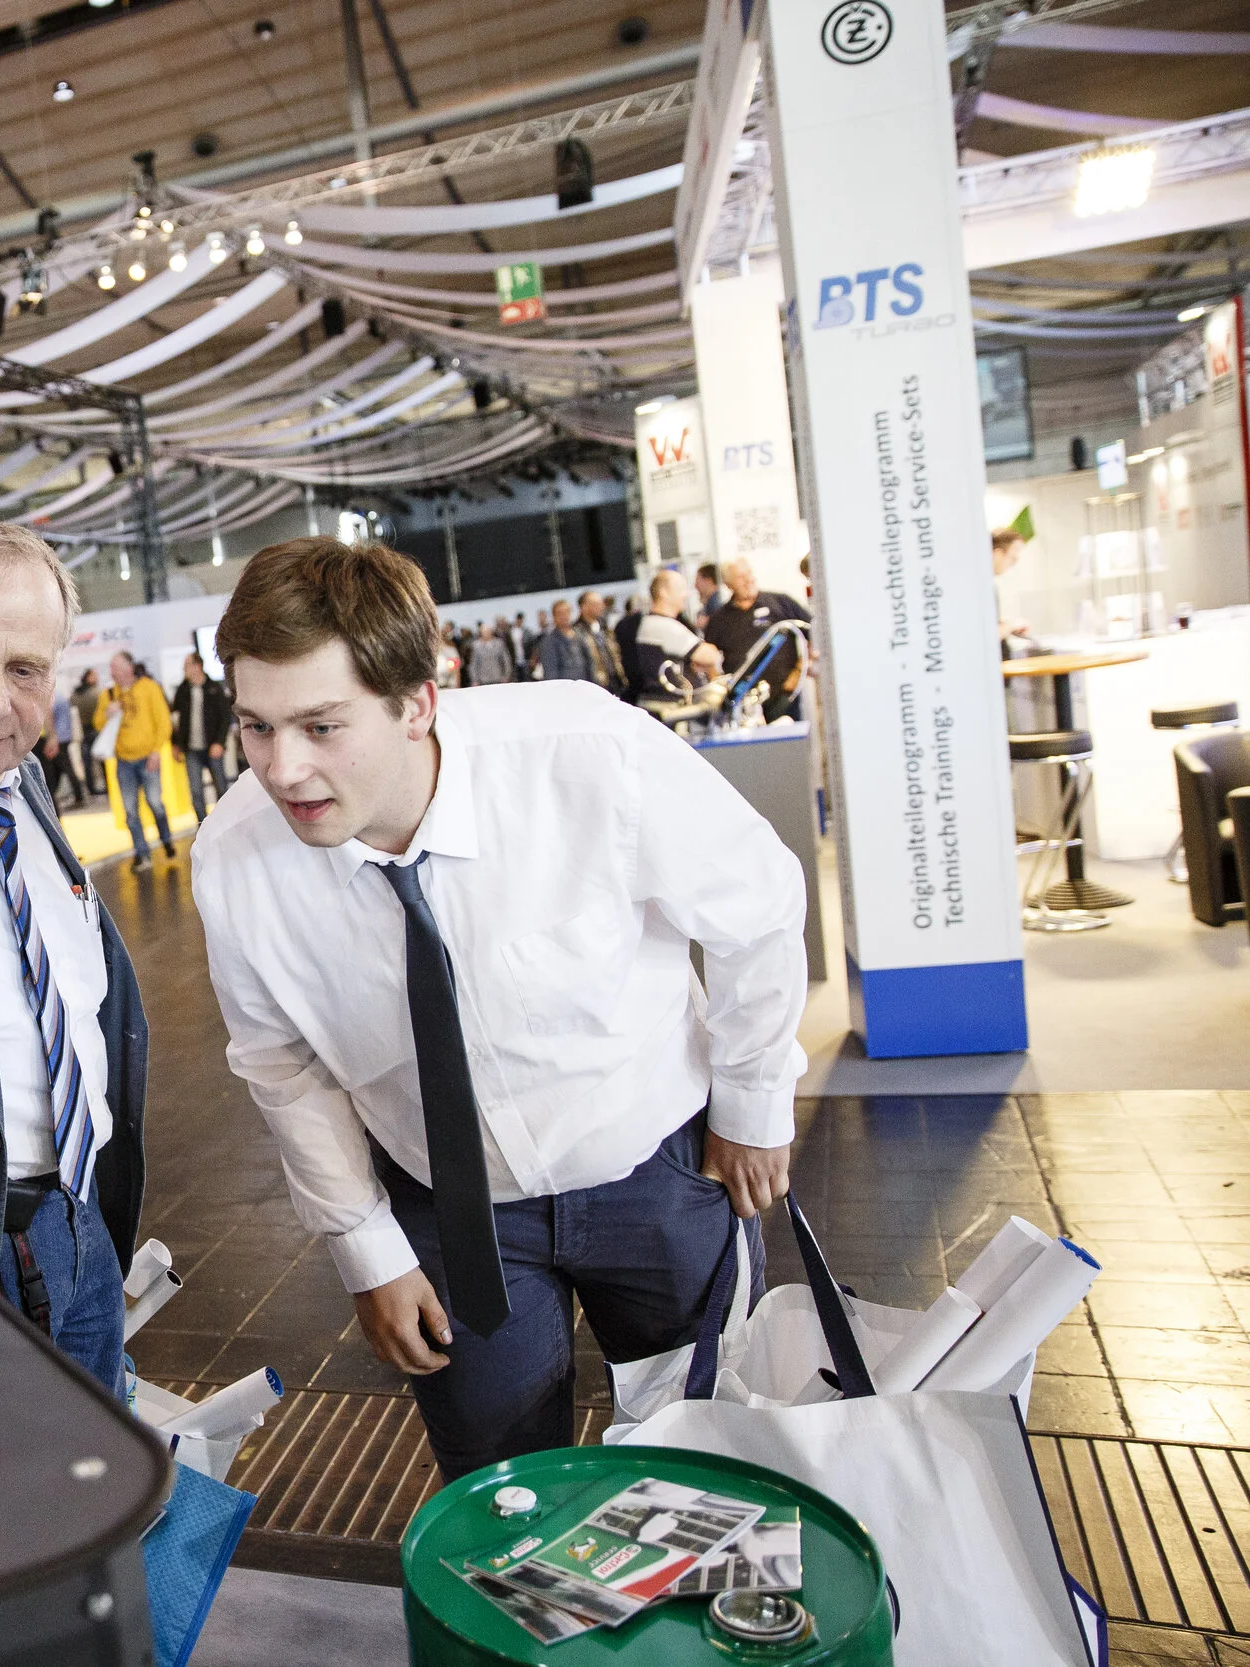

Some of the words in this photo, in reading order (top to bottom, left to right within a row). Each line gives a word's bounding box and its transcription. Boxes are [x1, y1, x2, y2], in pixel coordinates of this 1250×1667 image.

[816, 262, 925, 329] BTS
[723, 440, 774, 471] BTS
[902, 374, 931, 511] Service-Sets
[874, 410, 909, 650] Tauschteileprogramm
[911, 516, 935, 559] und
[921, 566, 944, 673] Montage-
[931, 705, 955, 804] Trainings
[899, 683, 936, 930] Originalteileprogramm
[937, 811, 964, 927] Technische
[598, 1551, 631, 1576] Castrol
